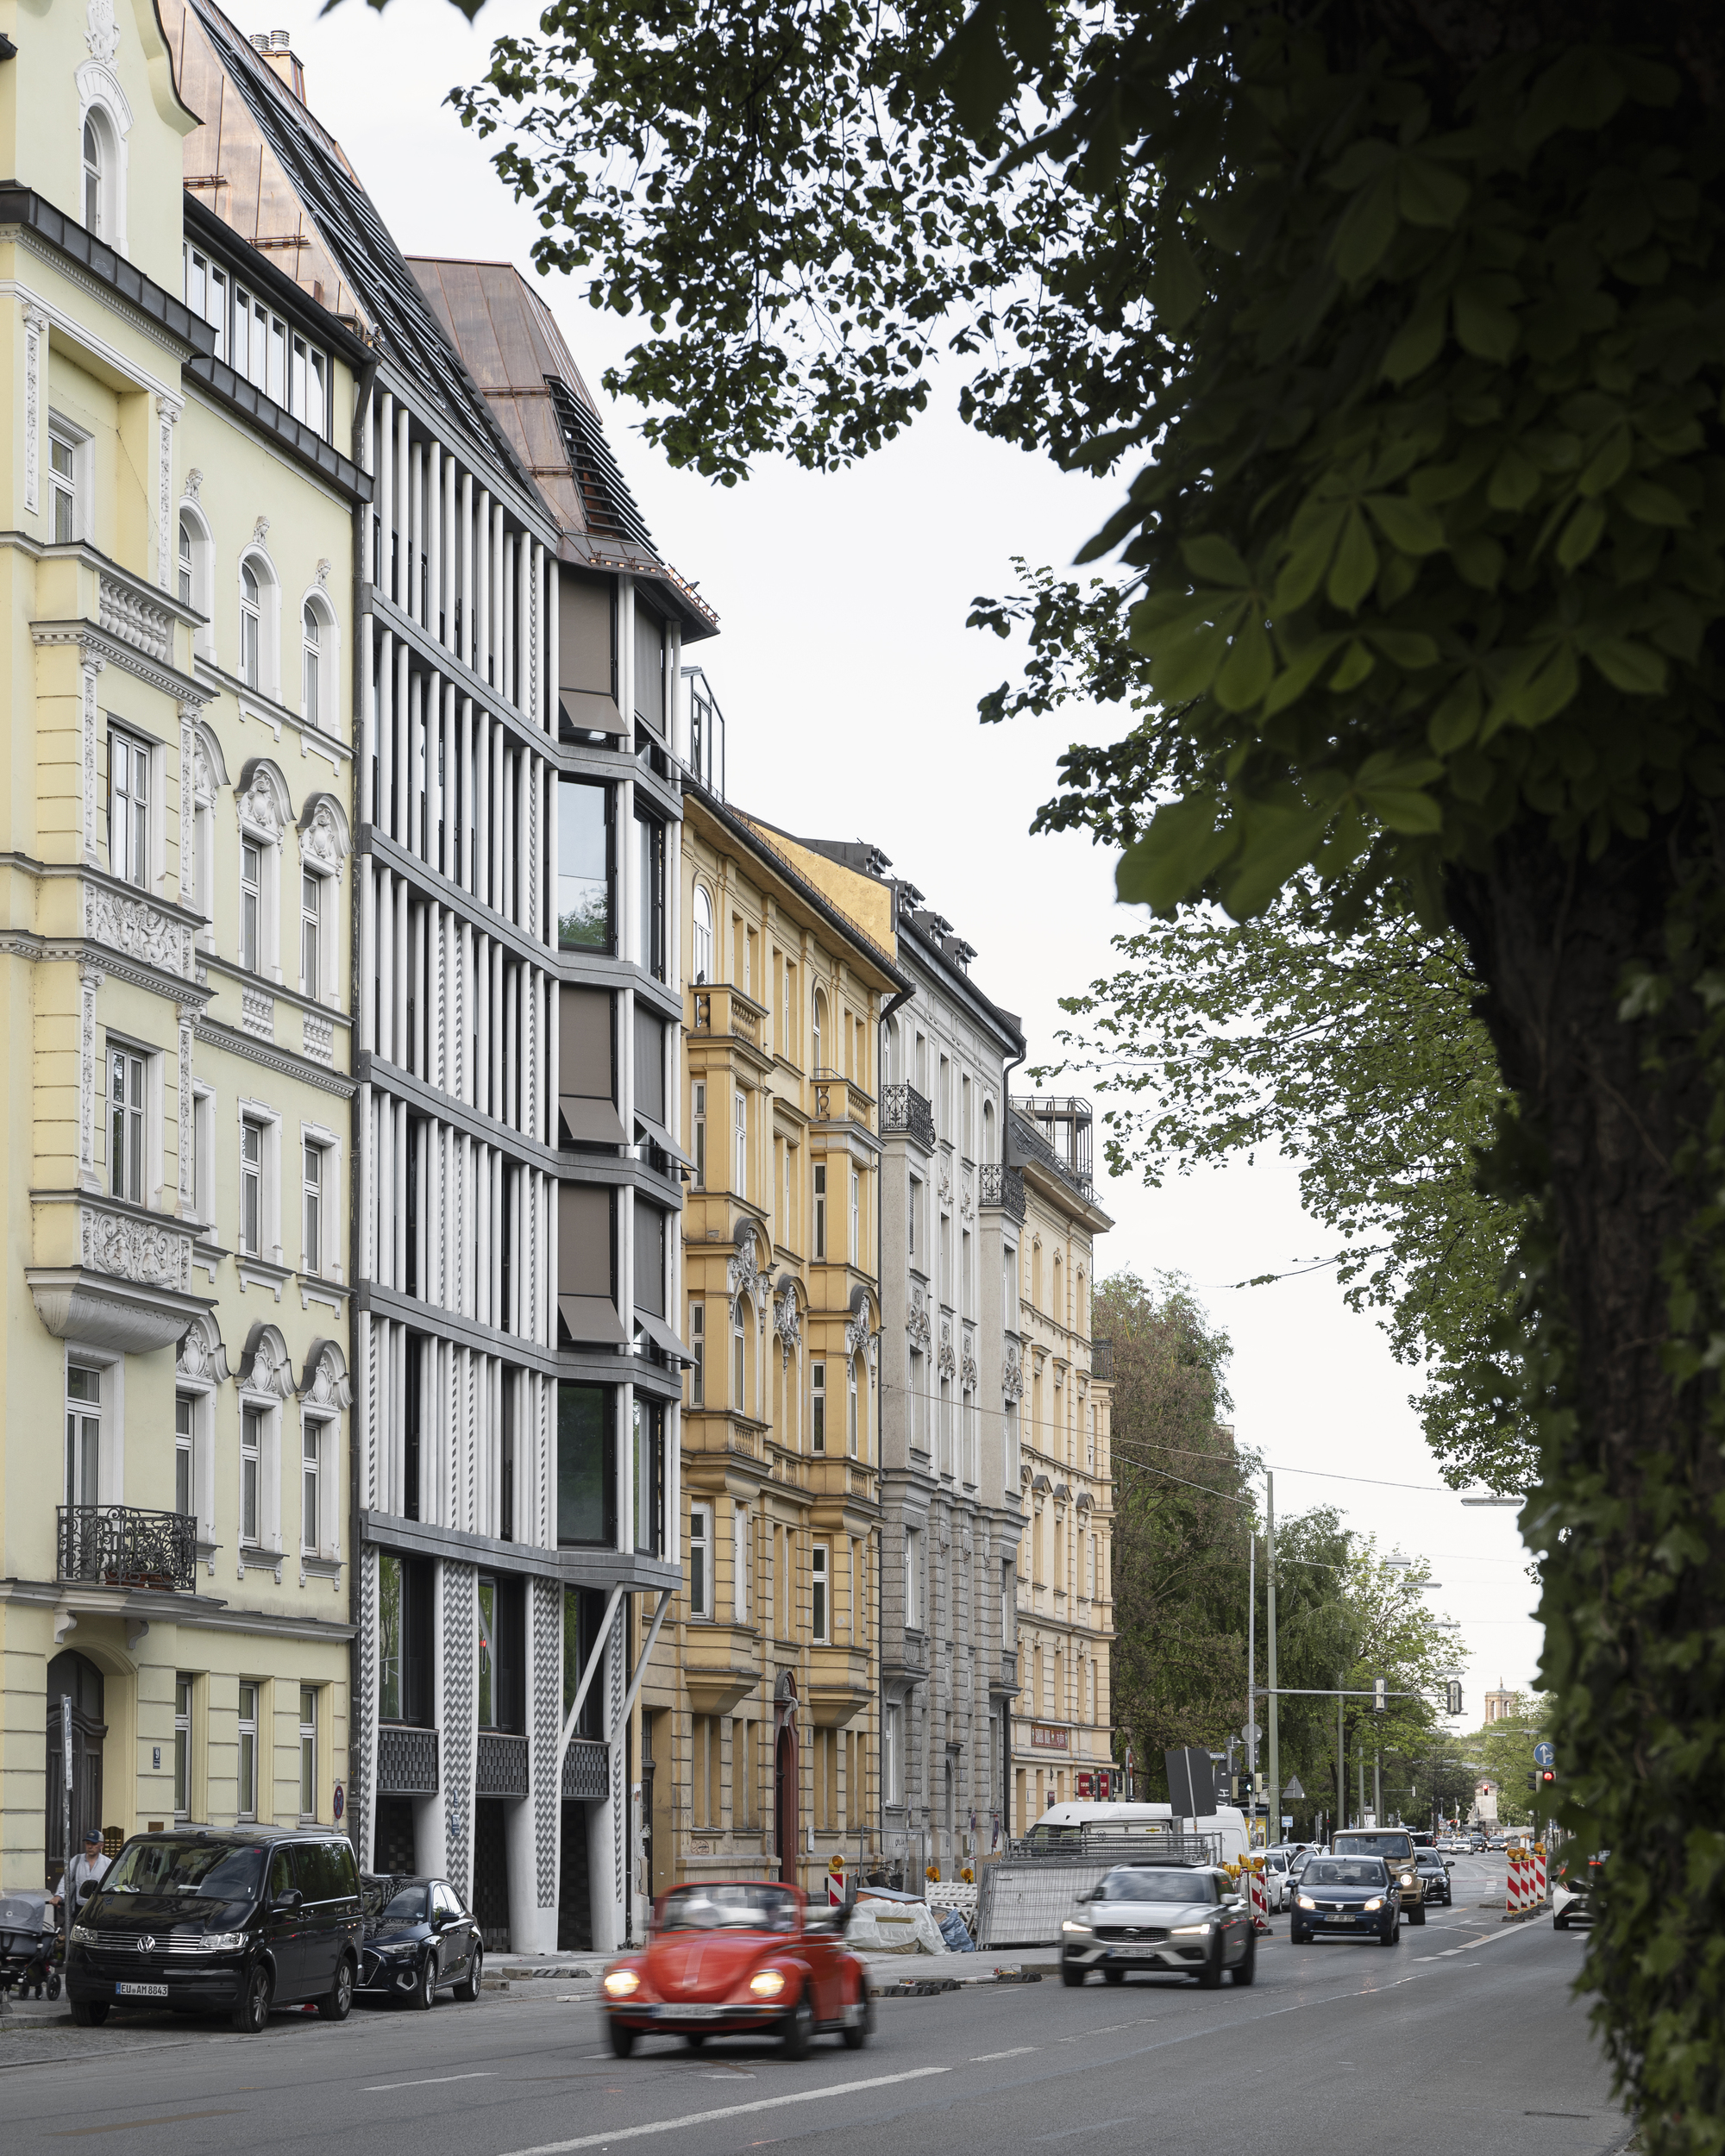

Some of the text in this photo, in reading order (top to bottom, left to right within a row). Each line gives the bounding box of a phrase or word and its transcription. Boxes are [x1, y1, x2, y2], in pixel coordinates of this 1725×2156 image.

[122, 1984, 167, 1995] EU AM 8843
